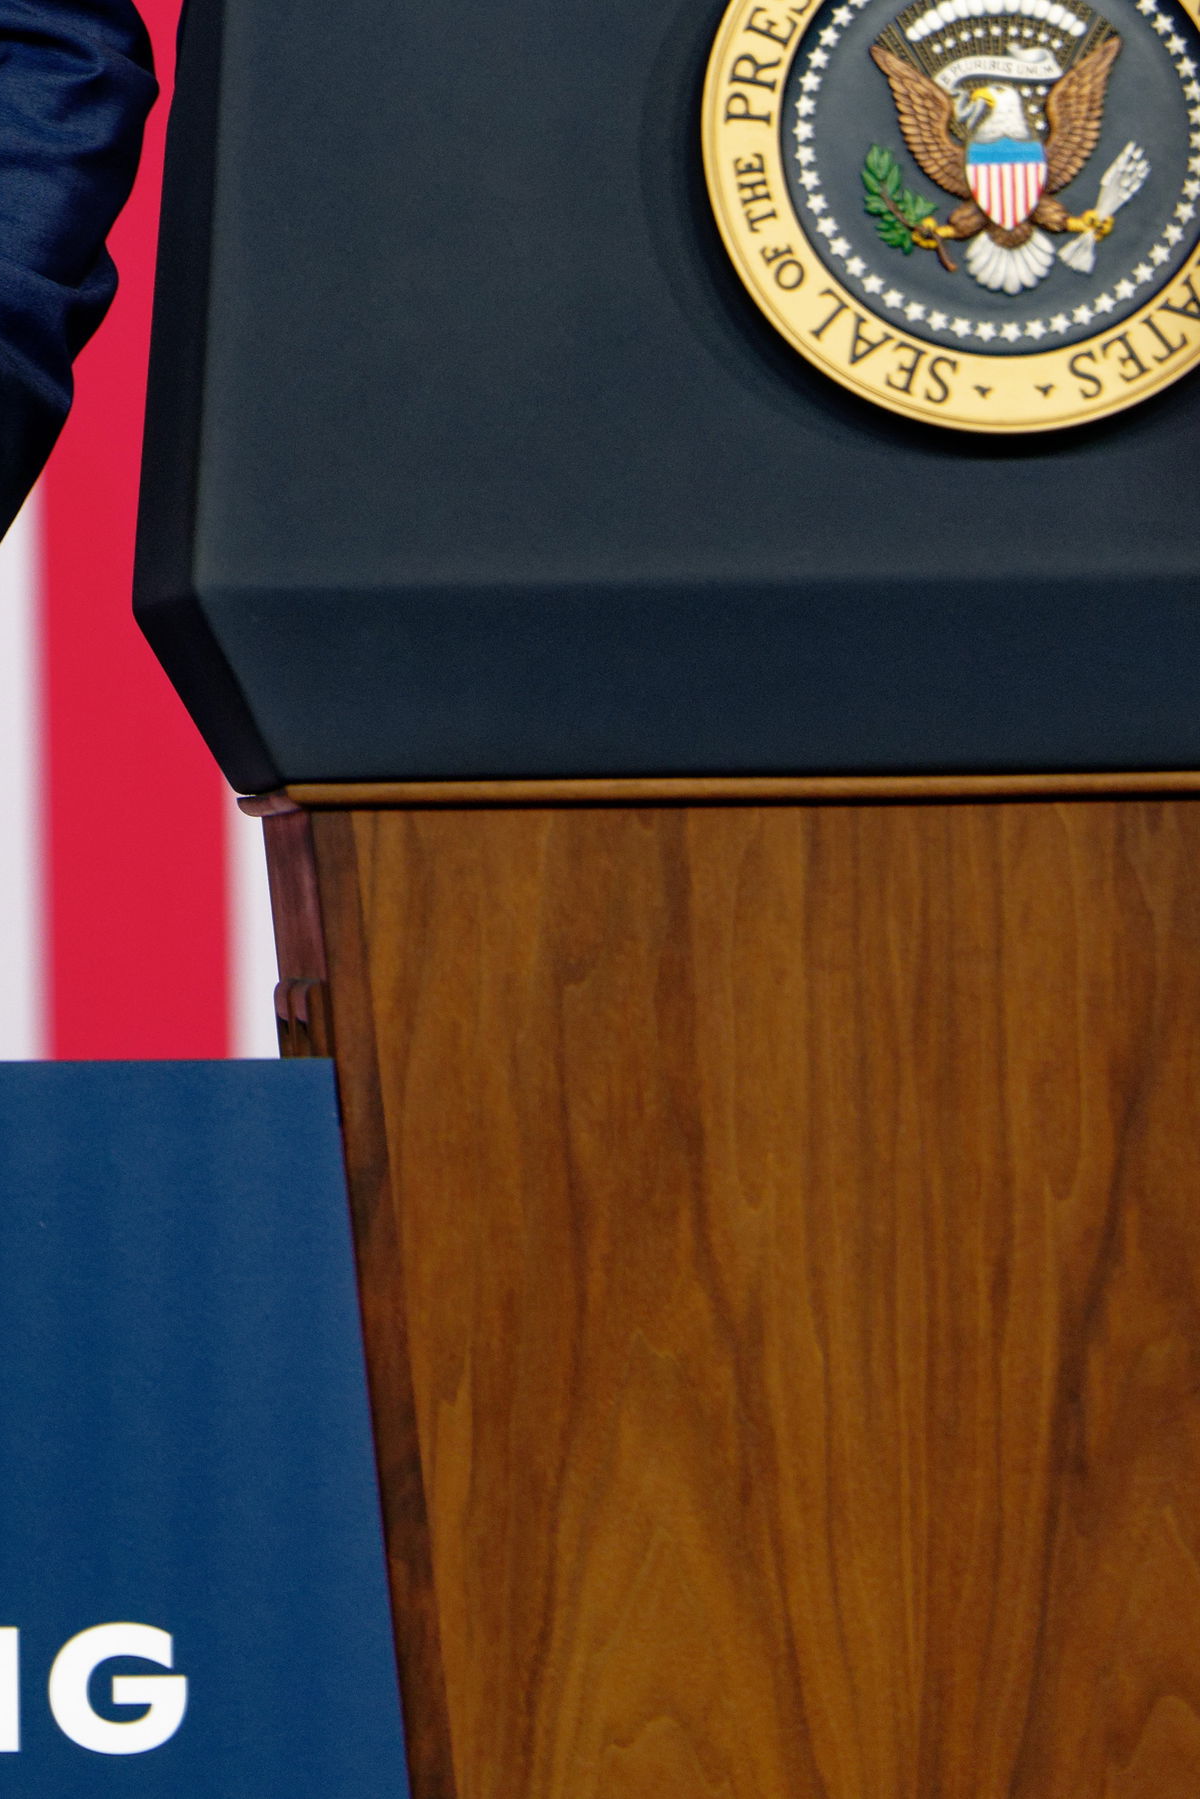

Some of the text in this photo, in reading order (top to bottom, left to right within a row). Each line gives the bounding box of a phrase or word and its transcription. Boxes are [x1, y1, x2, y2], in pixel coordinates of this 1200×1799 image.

[733, 153, 778, 234] THE
[760, 245, 806, 292] OF
[810, 288, 958, 405] SEAL
[1068, 260, 1200, 399] ATES
